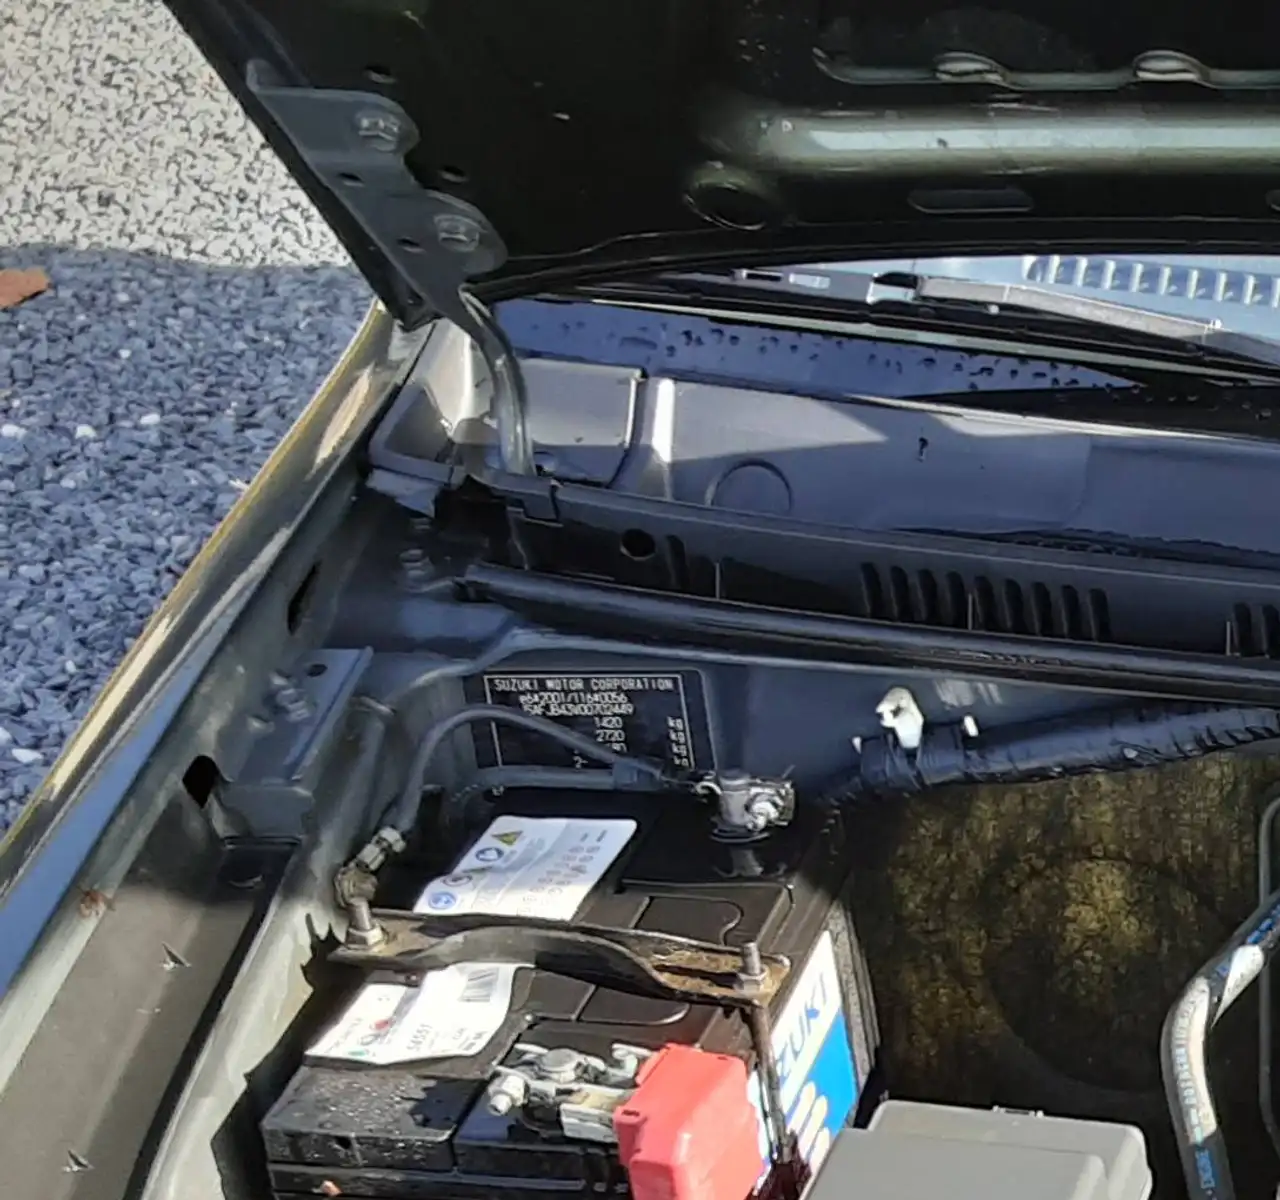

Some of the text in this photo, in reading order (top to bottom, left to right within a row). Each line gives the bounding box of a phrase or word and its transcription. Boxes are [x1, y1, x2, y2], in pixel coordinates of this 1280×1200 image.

[495, 678, 675, 692] SUZUKI MOTOR CORPORATION
